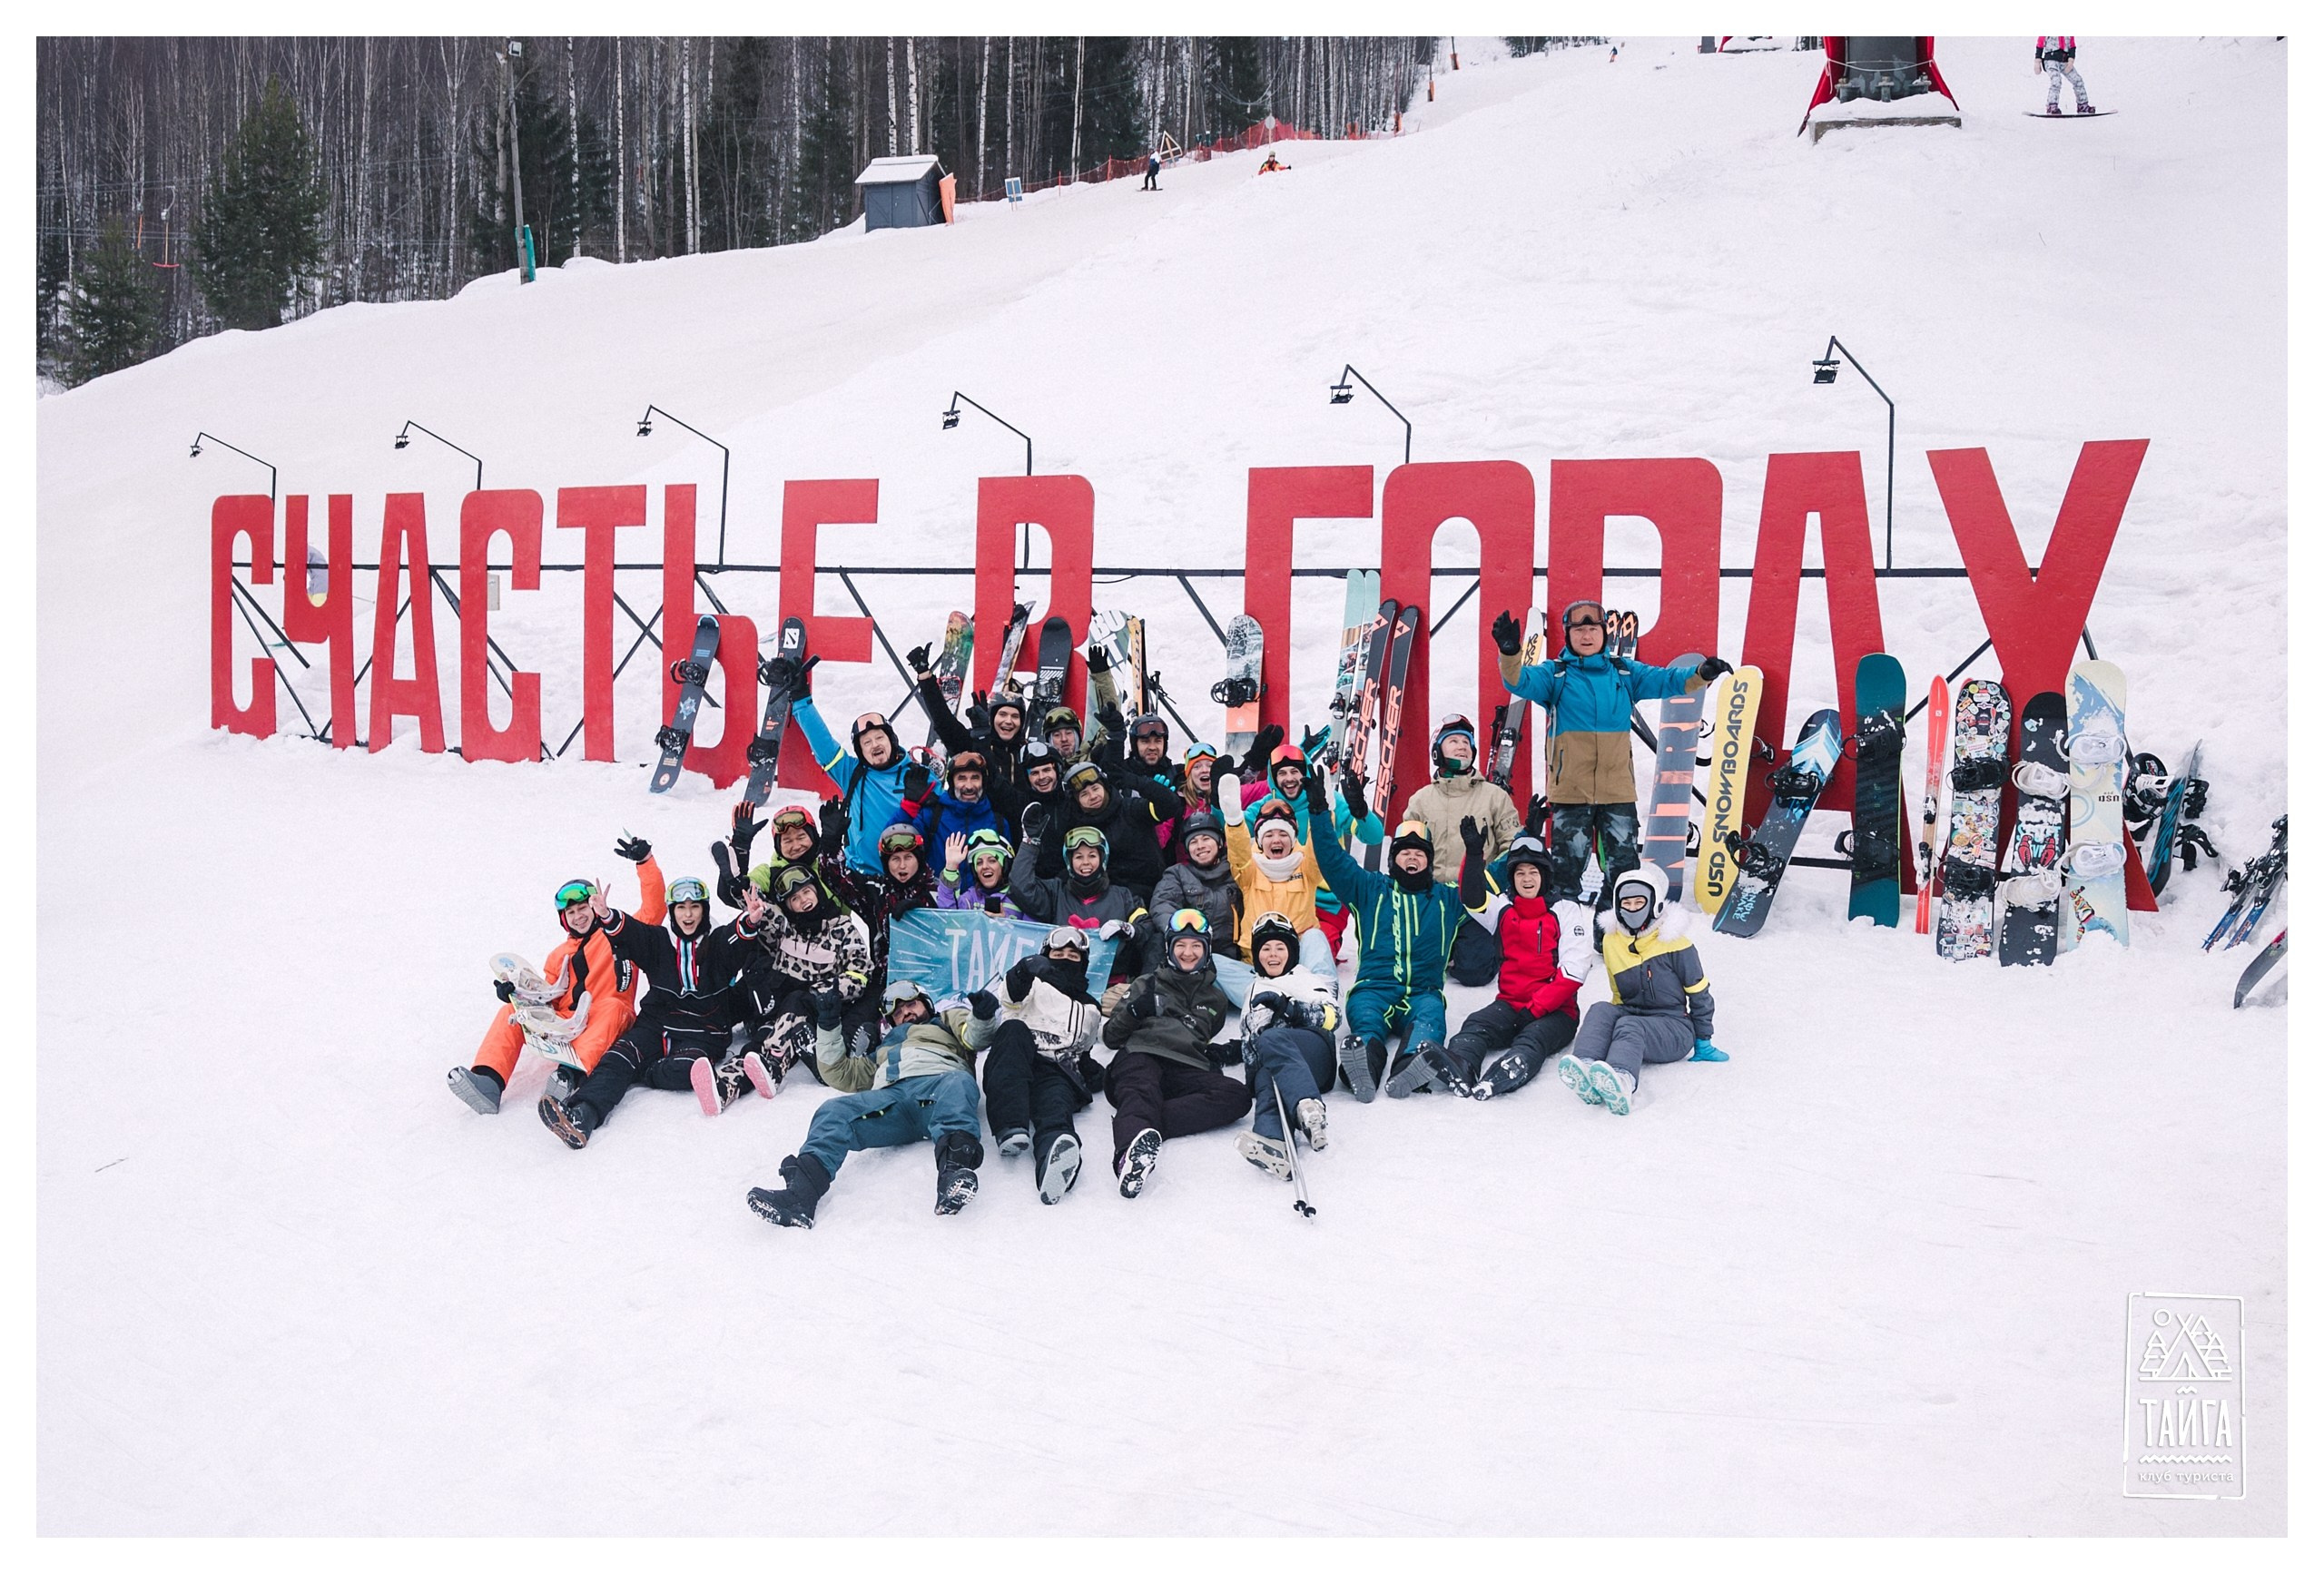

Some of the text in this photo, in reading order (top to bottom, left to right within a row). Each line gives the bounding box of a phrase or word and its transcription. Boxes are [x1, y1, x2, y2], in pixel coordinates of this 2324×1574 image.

[212, 438, 2158, 911] СЧАСТЬЕ В ГОРАХ
[1351, 677, 1377, 782] SCHER
[1374, 685, 1403, 818] FISCHER
[1708, 679, 1748, 897] USD SNOWBOARDS
